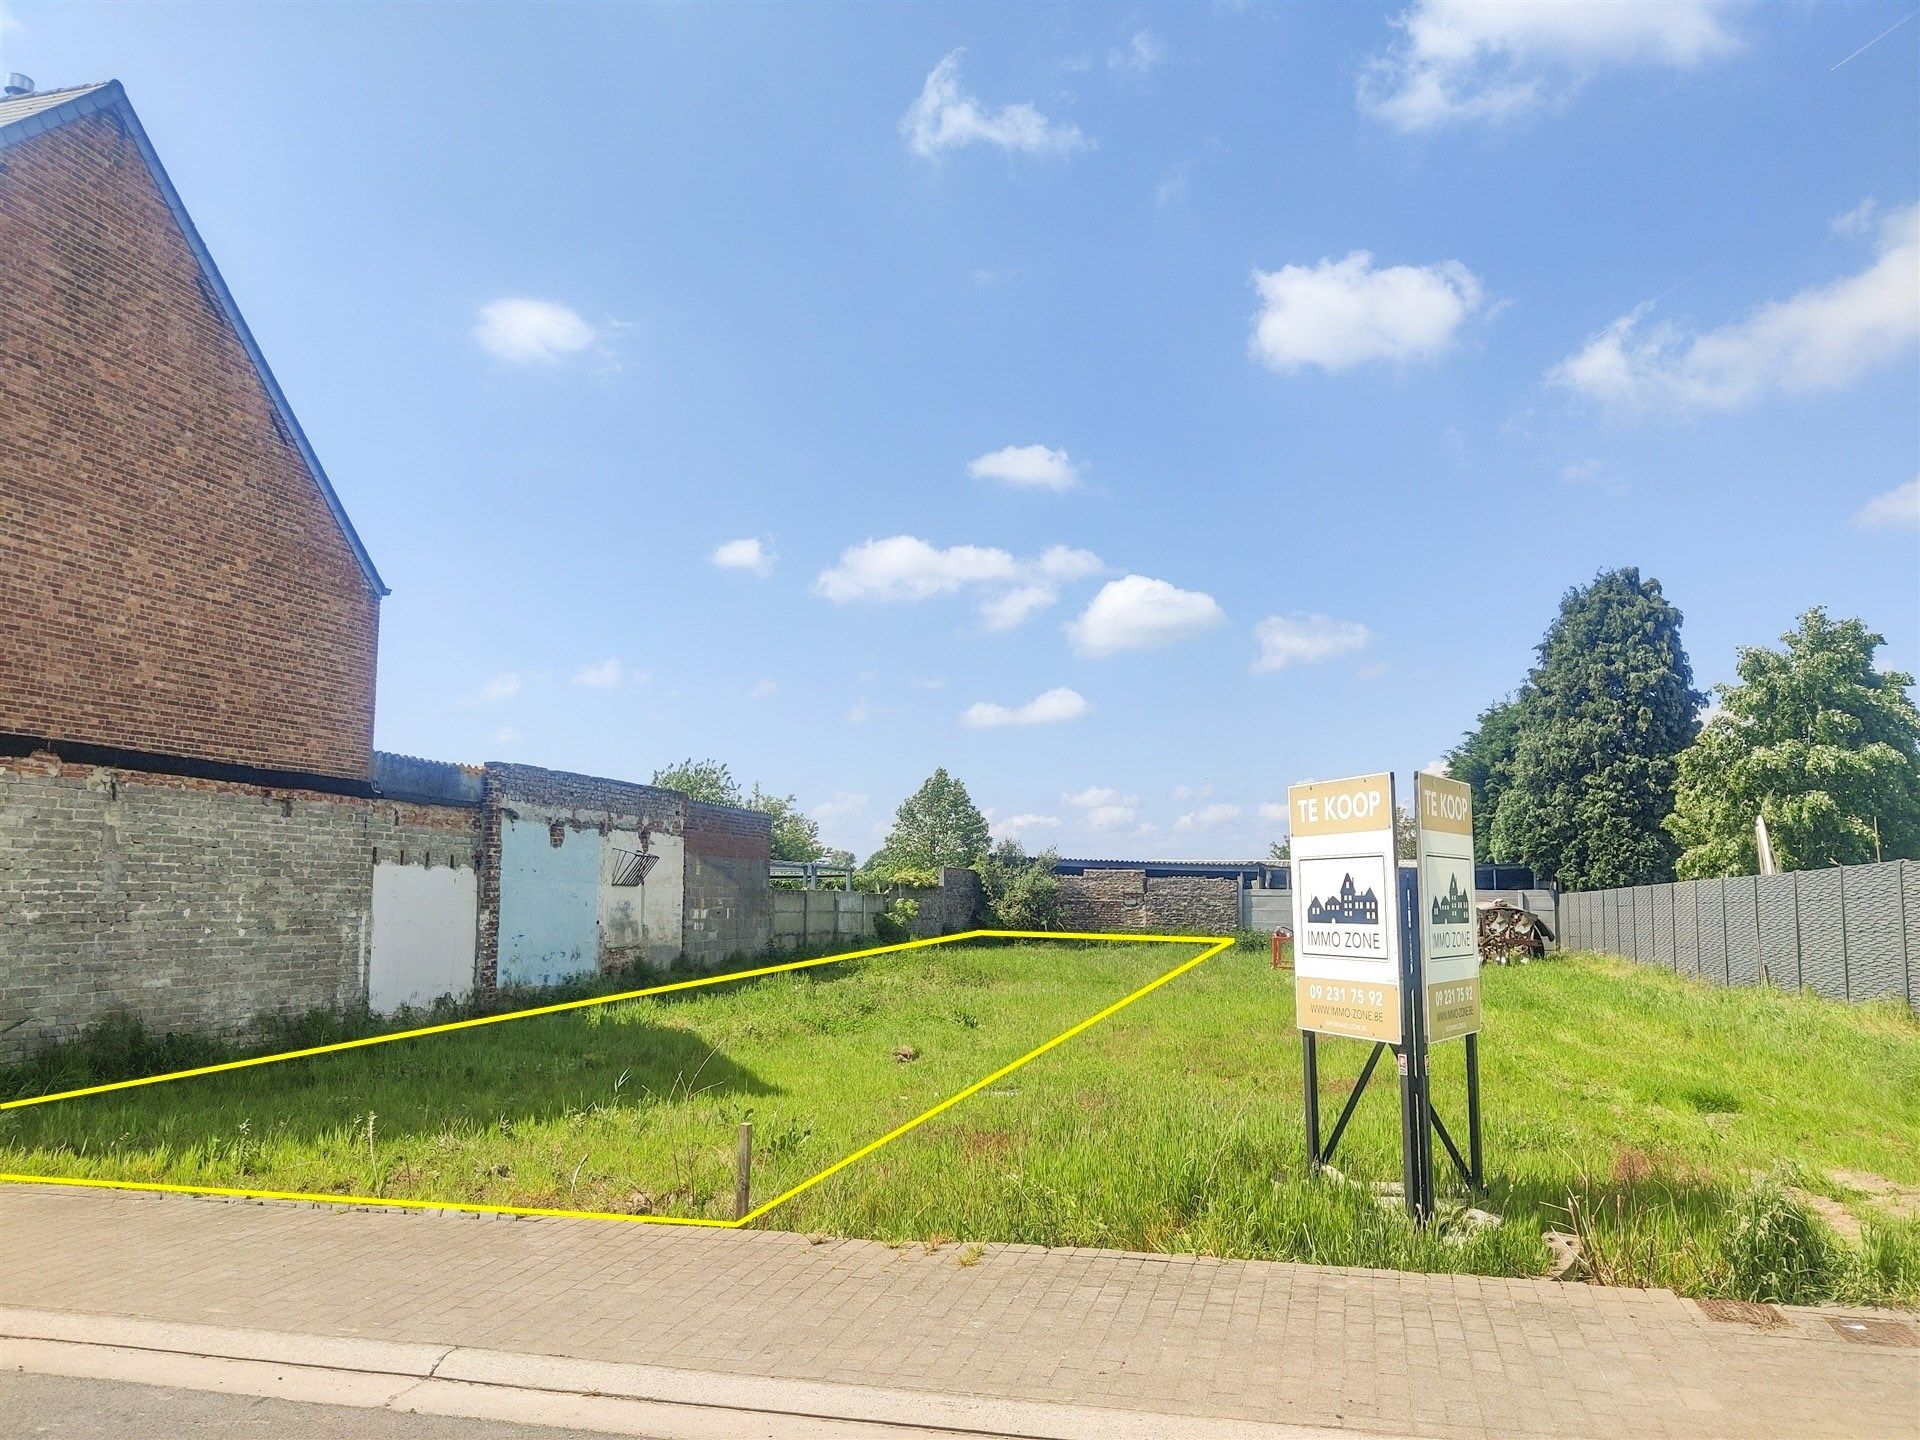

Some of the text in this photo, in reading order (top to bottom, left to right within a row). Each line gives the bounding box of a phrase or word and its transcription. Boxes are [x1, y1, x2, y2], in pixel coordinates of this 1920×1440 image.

[1297, 791, 1381, 822] TE KOOP
[1425, 790, 1468, 821] TE KOOP
[1308, 931, 1380, 949] IMMO ZONE
[1433, 931, 1470, 948] IMMO ZONE
[1309, 986, 1383, 1006] 09 231 75 92
[1435, 986, 1473, 1006] 09 231 75 92
[1311, 1004, 1383, 1022] WWW.IMMO-ZONE.BE
